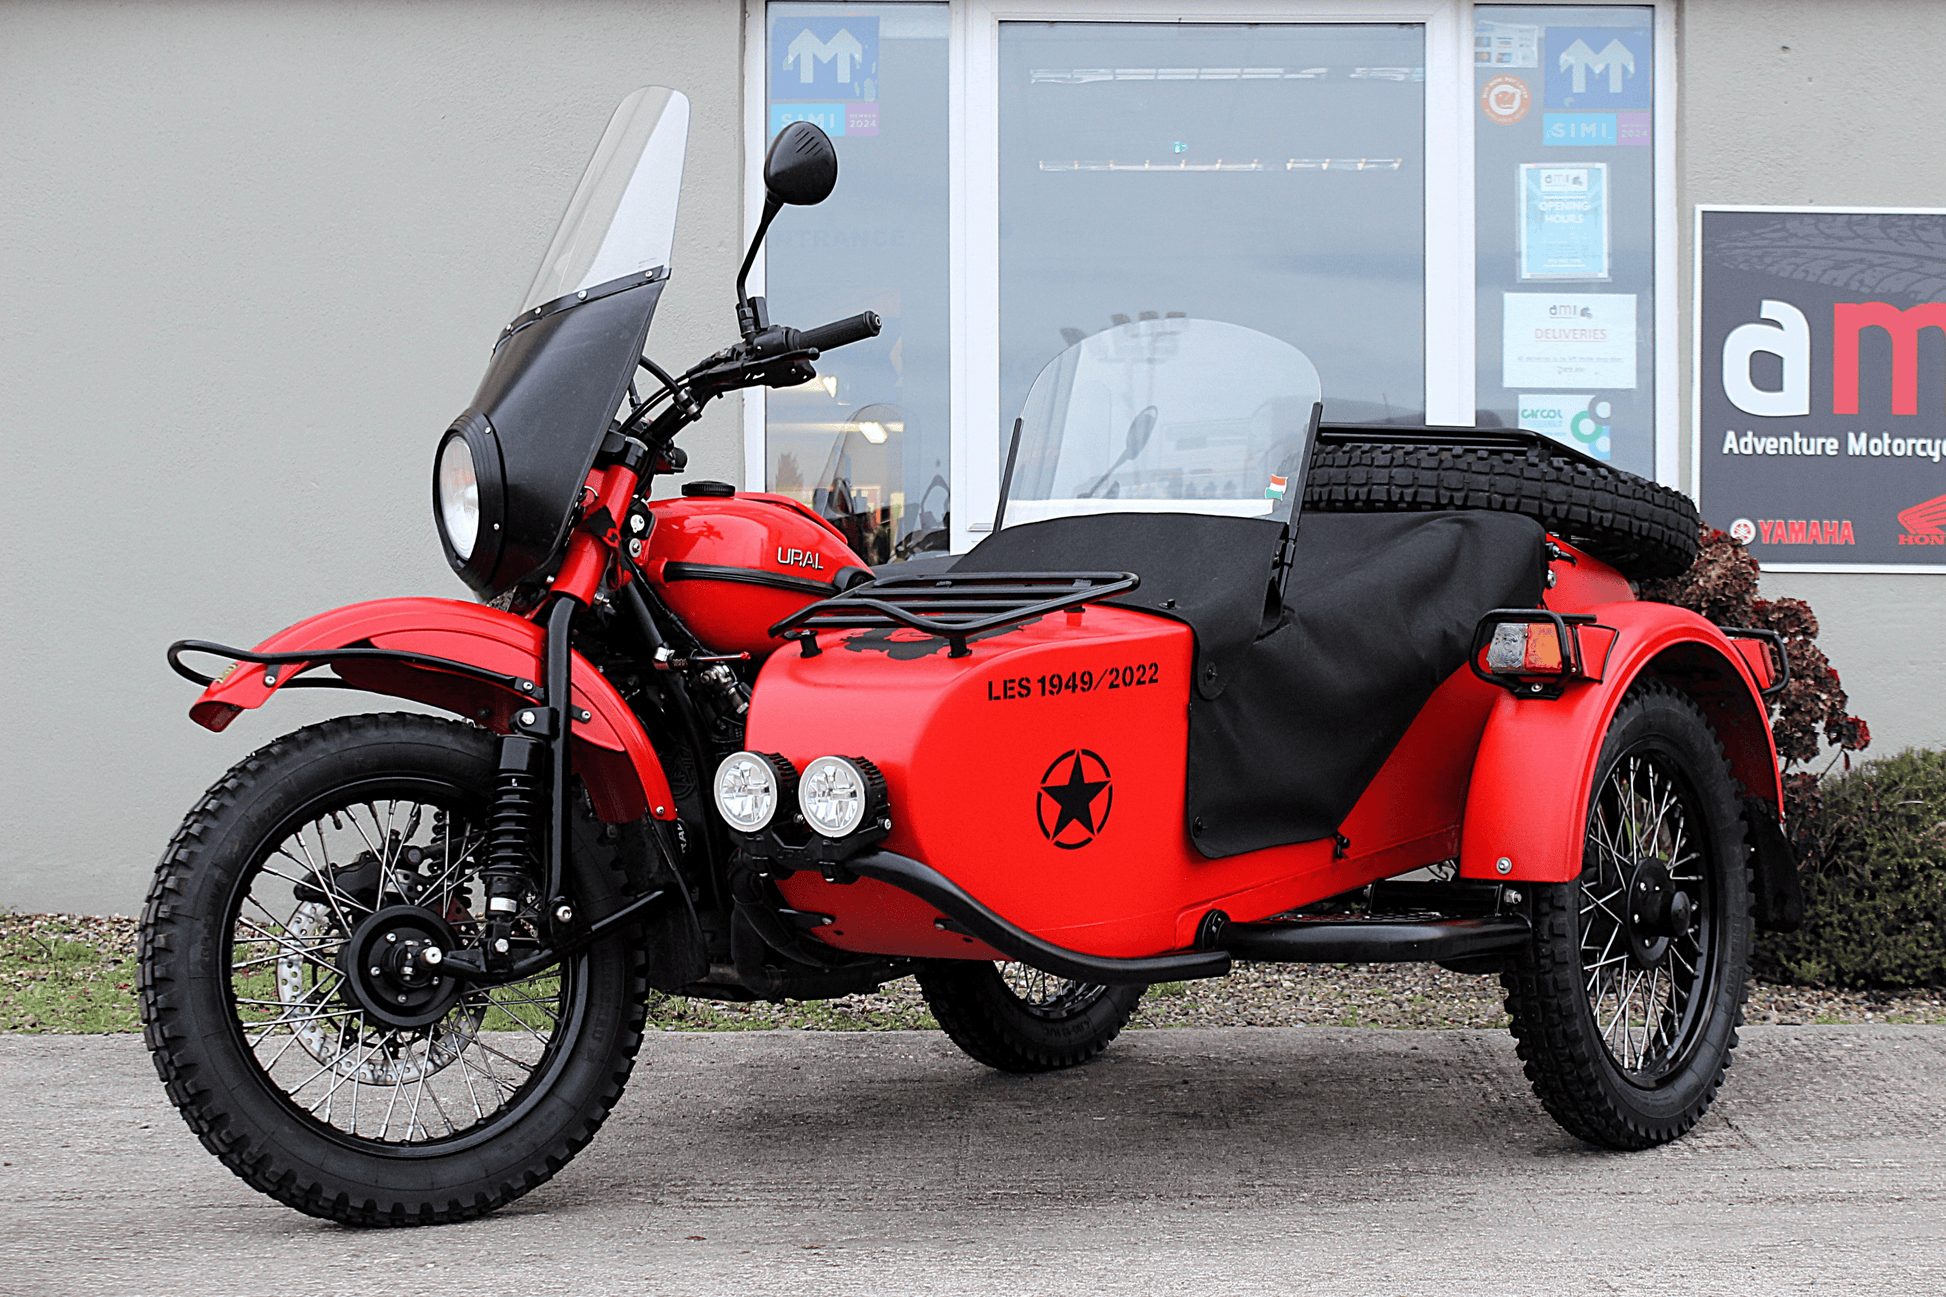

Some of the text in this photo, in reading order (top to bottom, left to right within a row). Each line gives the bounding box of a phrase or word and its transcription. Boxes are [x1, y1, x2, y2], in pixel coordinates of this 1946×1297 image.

[849, 119, 877, 128] 2024
[1551, 122, 1607, 138] SIMI
[1621, 129, 1648, 138] 2024
[1538, 201, 1591, 211] OPENING
[1544, 214, 1585, 223] HOURS
[773, 229, 906, 248] NTRANCE
[1535, 328, 1607, 340] DELIVERIES
[1722, 431, 1839, 456] Adventure
[1758, 520, 1855, 545] YAMAHA
[777, 546, 824, 571] URAL
[988, 662, 1159, 701] LES 1949/2022
